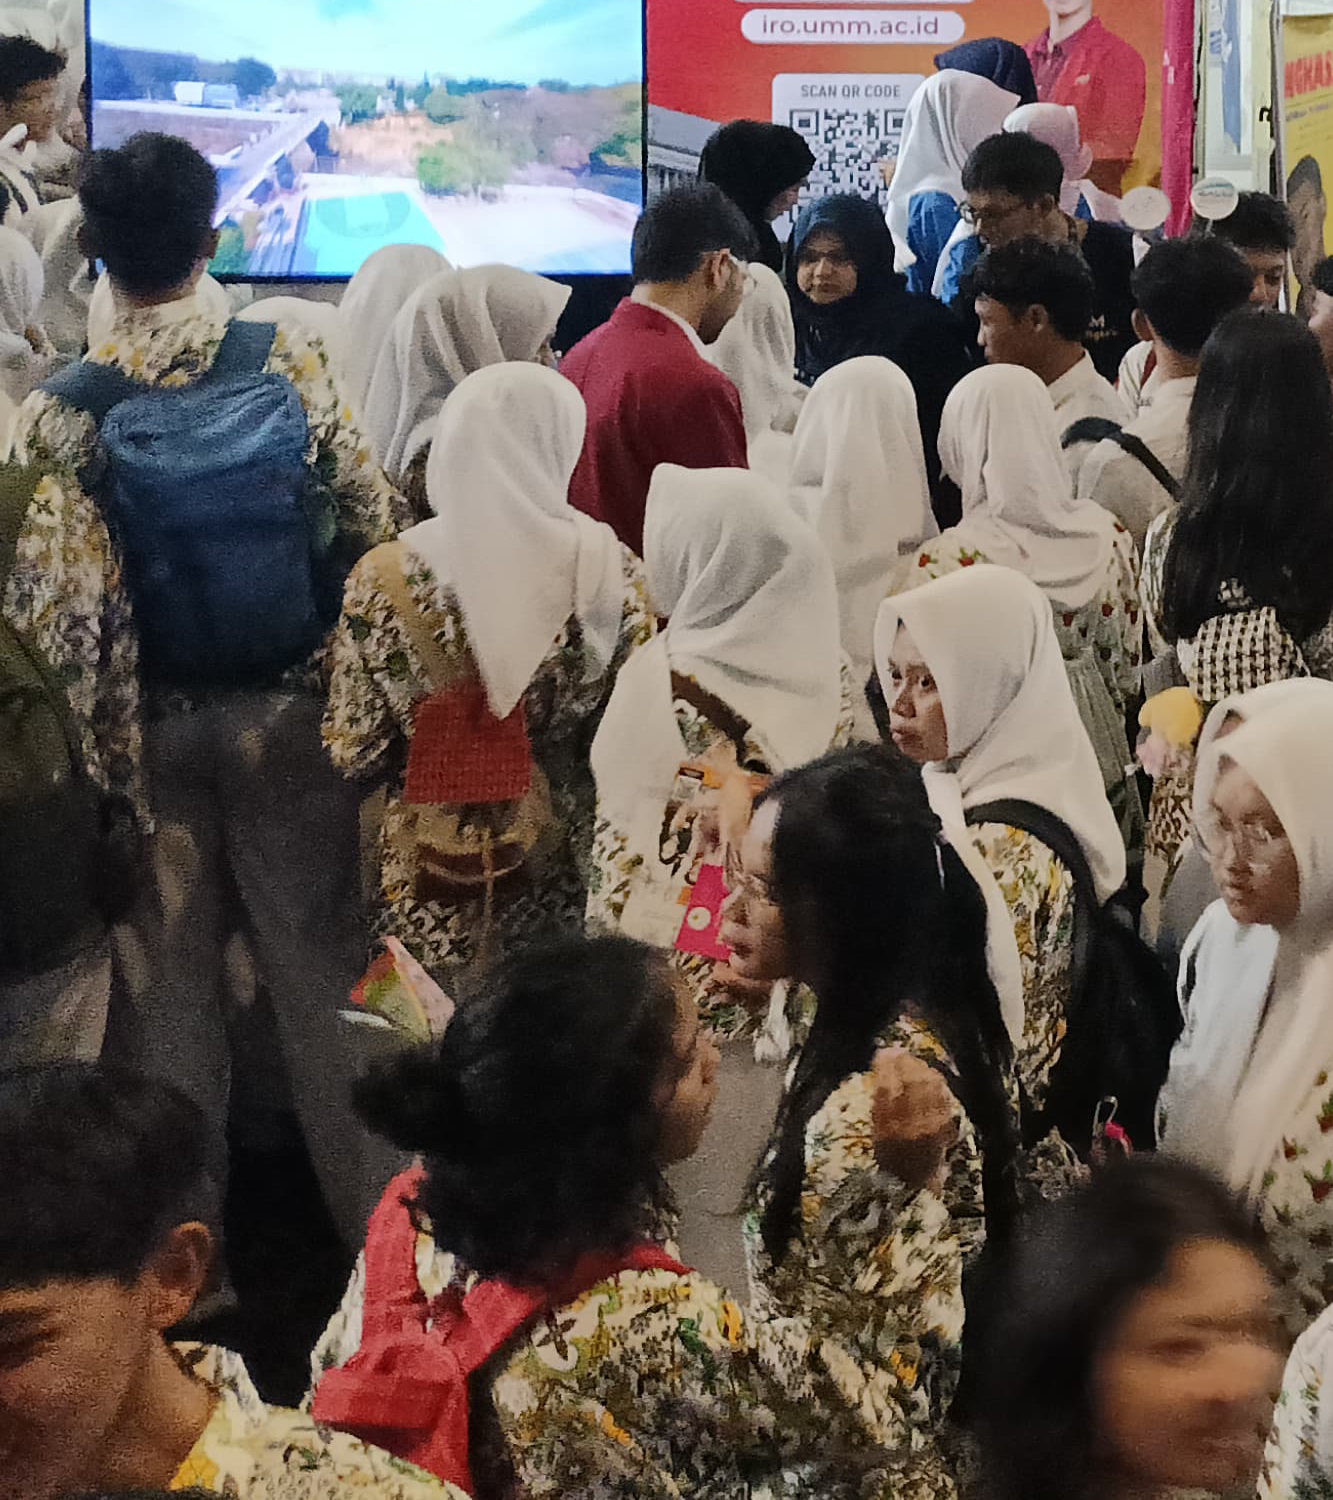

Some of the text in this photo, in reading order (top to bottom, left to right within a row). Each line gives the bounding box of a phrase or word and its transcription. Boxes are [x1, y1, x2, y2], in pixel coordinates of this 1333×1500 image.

[762, 14, 939, 35] iro.umm.ac.id
[801, 84, 901, 99] SCAN QR CODE
